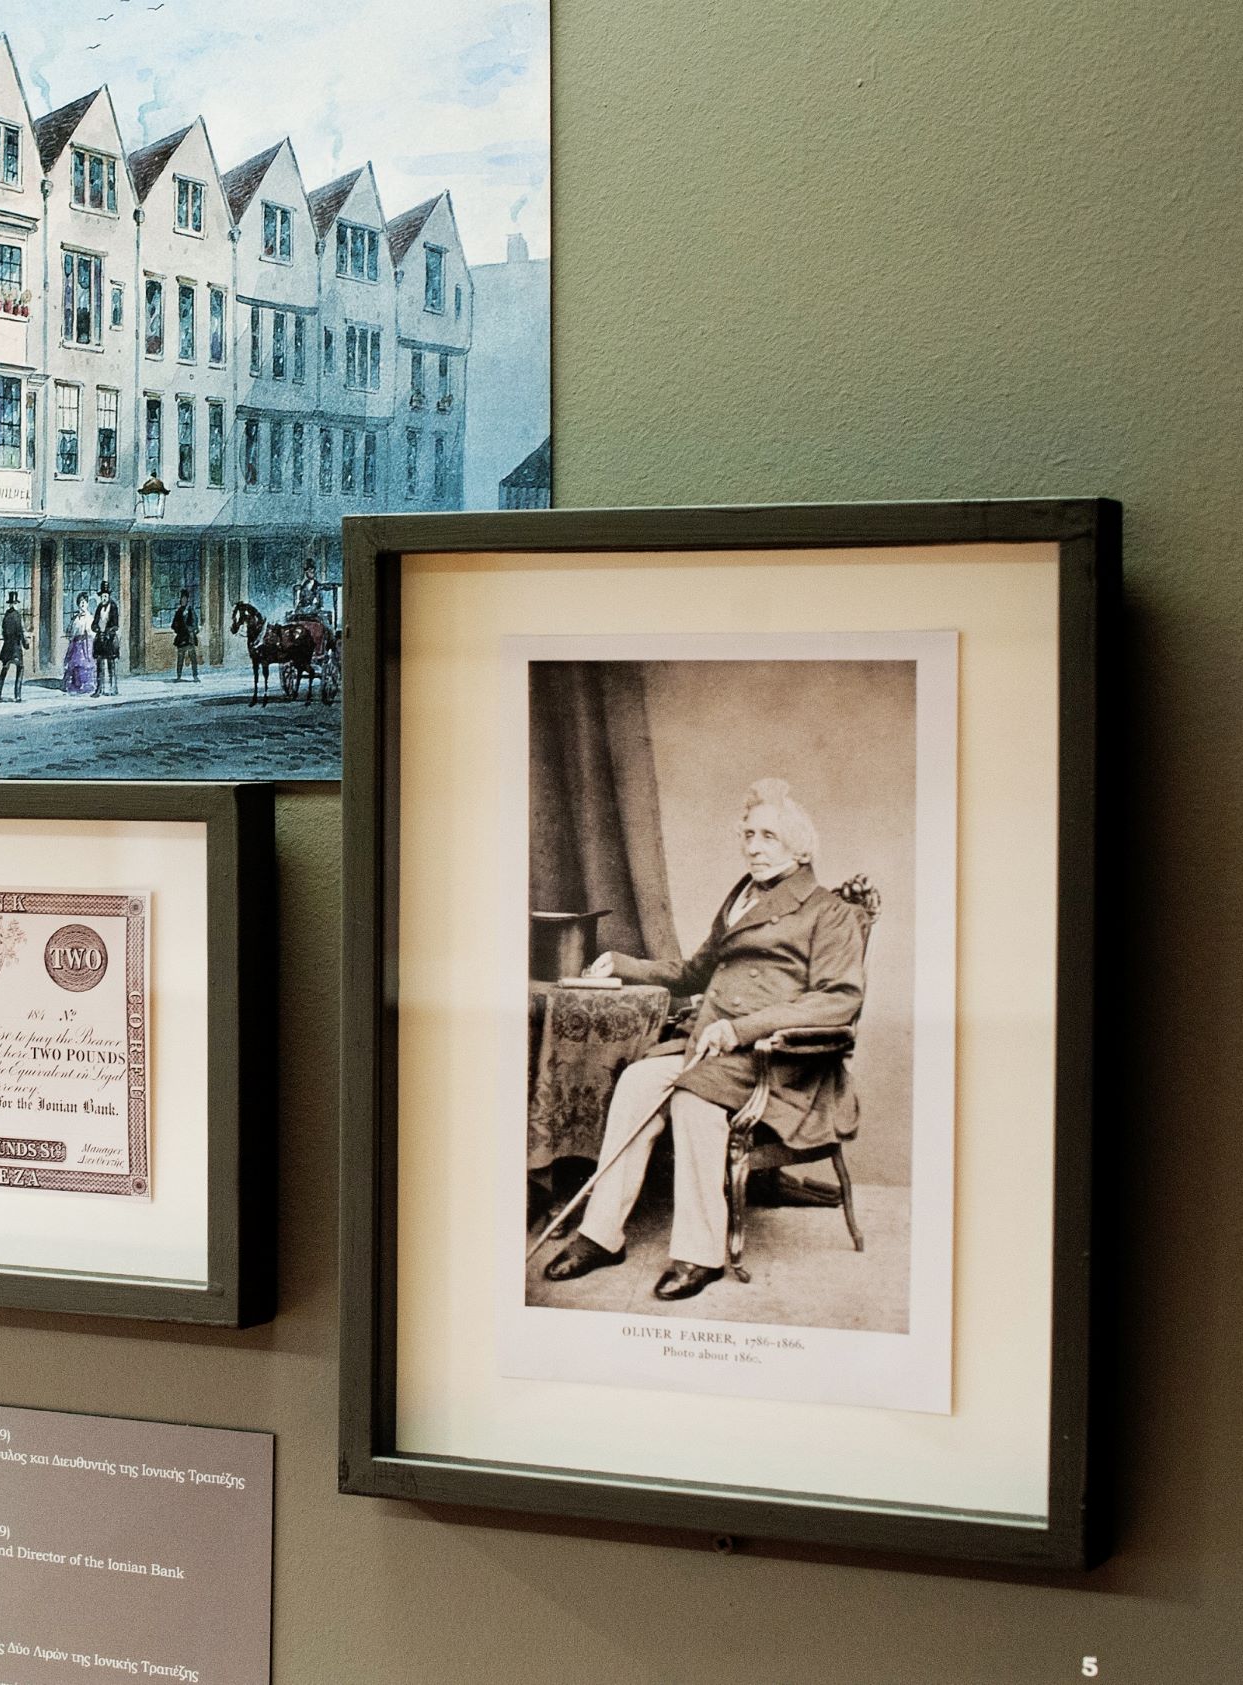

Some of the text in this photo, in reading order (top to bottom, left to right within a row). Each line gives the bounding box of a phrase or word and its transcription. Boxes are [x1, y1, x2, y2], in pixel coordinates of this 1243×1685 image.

[50, 948, 104, 971] TWO
[26, 1032, 52, 1050] pay
[55, 1027, 74, 1045] the
[128, 990, 145, 1101] CORFU
[30, 1046, 62, 1062] TWO
[66, 1049, 126, 1065] POUNDS
[17, 1098, 33, 1110] the
[38, 1097, 78, 1113] Ionian
[83, 1098, 119, 1116] Bank.
[622, 1326, 672, 1340] OLIVER
[679, 1330, 737, 1346] FARRER,
[662, 1346, 695, 1359] Photo
[698, 1348, 729, 1362] about
[29, 1455, 50, 1466] και
[52, 1454, 117, 1476] Διευθυντής
[119, 1465, 139, 1478] της
[142, 1463, 186, 1483] Ιονικής
[187, 1468, 246, 1490] Τραπέζης
[17, 1546, 67, 1564] Director
[69, 1554, 83, 1567] of
[84, 1556, 105, 1569] the
[108, 1558, 147, 1575] Ionian
[150, 1563, 186, 1580] Bank
[7, 1641, 31, 1656] Δύο
[33, 1645, 69, 1661] Λιρών
[71, 1653, 91, 1667] της
[94, 1653, 138, 1674] Ιονικής
[140, 1659, 199, 1683] Τραπέζης
[1081, 1655, 1098, 1677] 5
